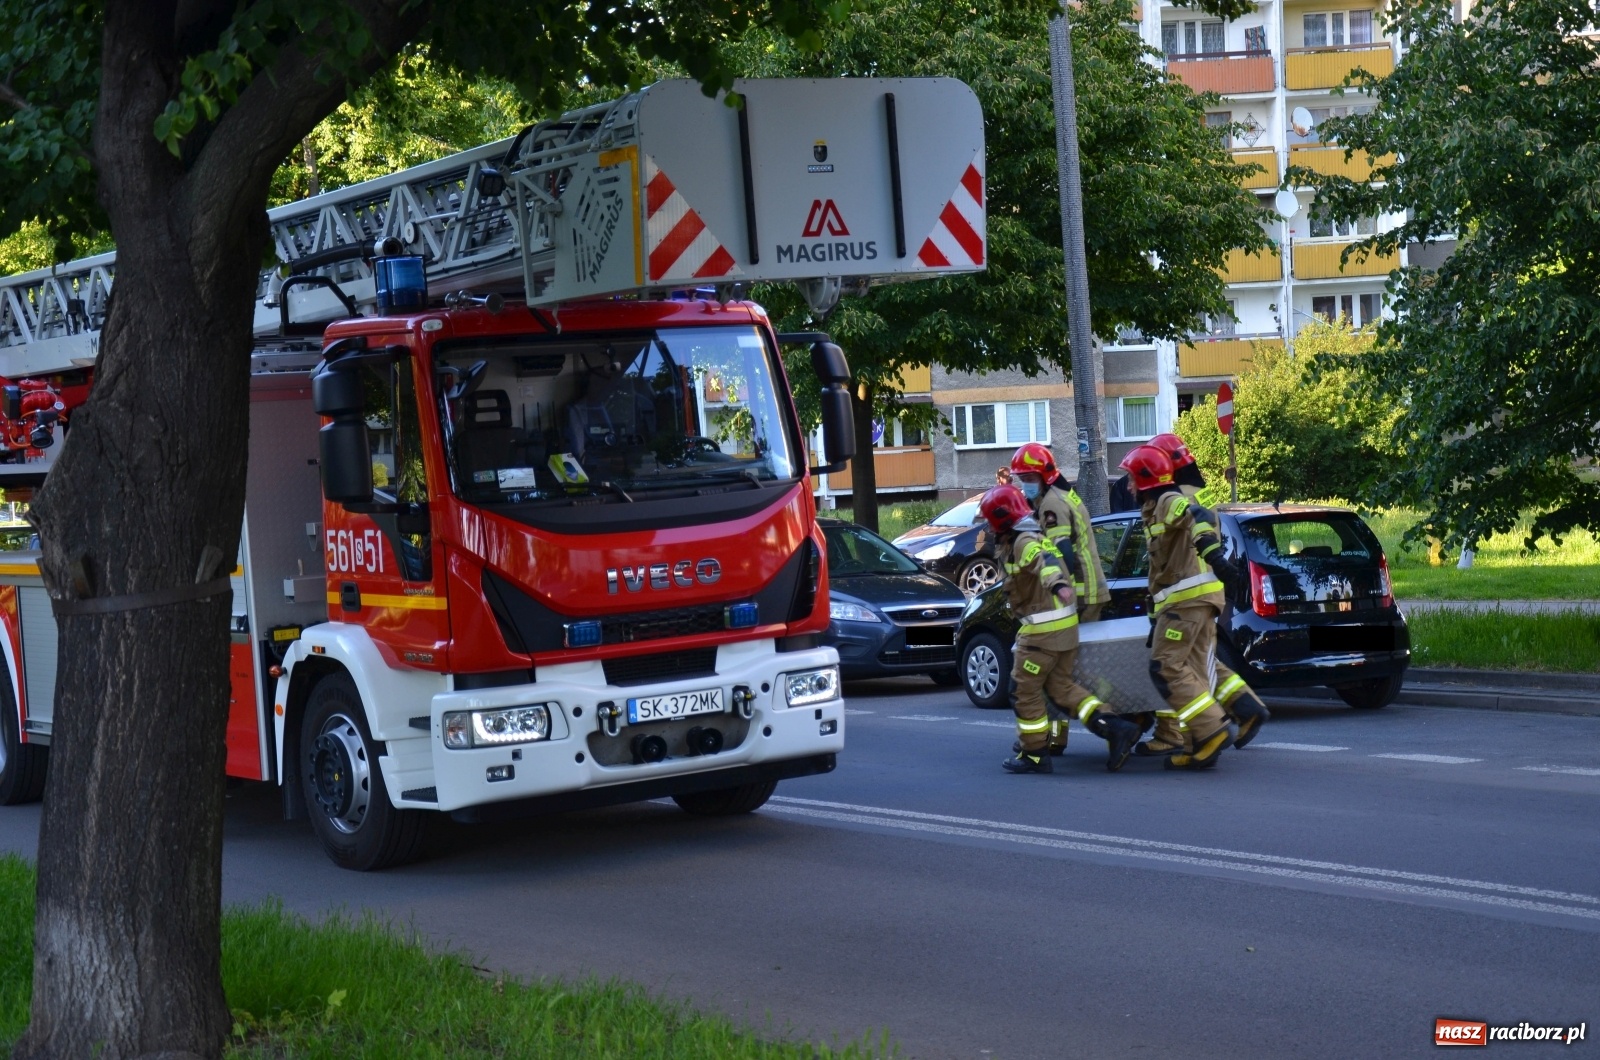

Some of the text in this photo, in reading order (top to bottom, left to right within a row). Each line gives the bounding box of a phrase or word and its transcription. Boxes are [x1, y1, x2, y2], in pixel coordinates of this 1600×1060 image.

[589, 193, 624, 284] MAGIRUS
[776, 241, 878, 263] MAGIRUS
[607, 557, 722, 595] IVECO
[1167, 630, 1180, 640] PSP
[1024, 662, 1038, 673] PSP
[640, 691, 720, 718] SK 372MK
